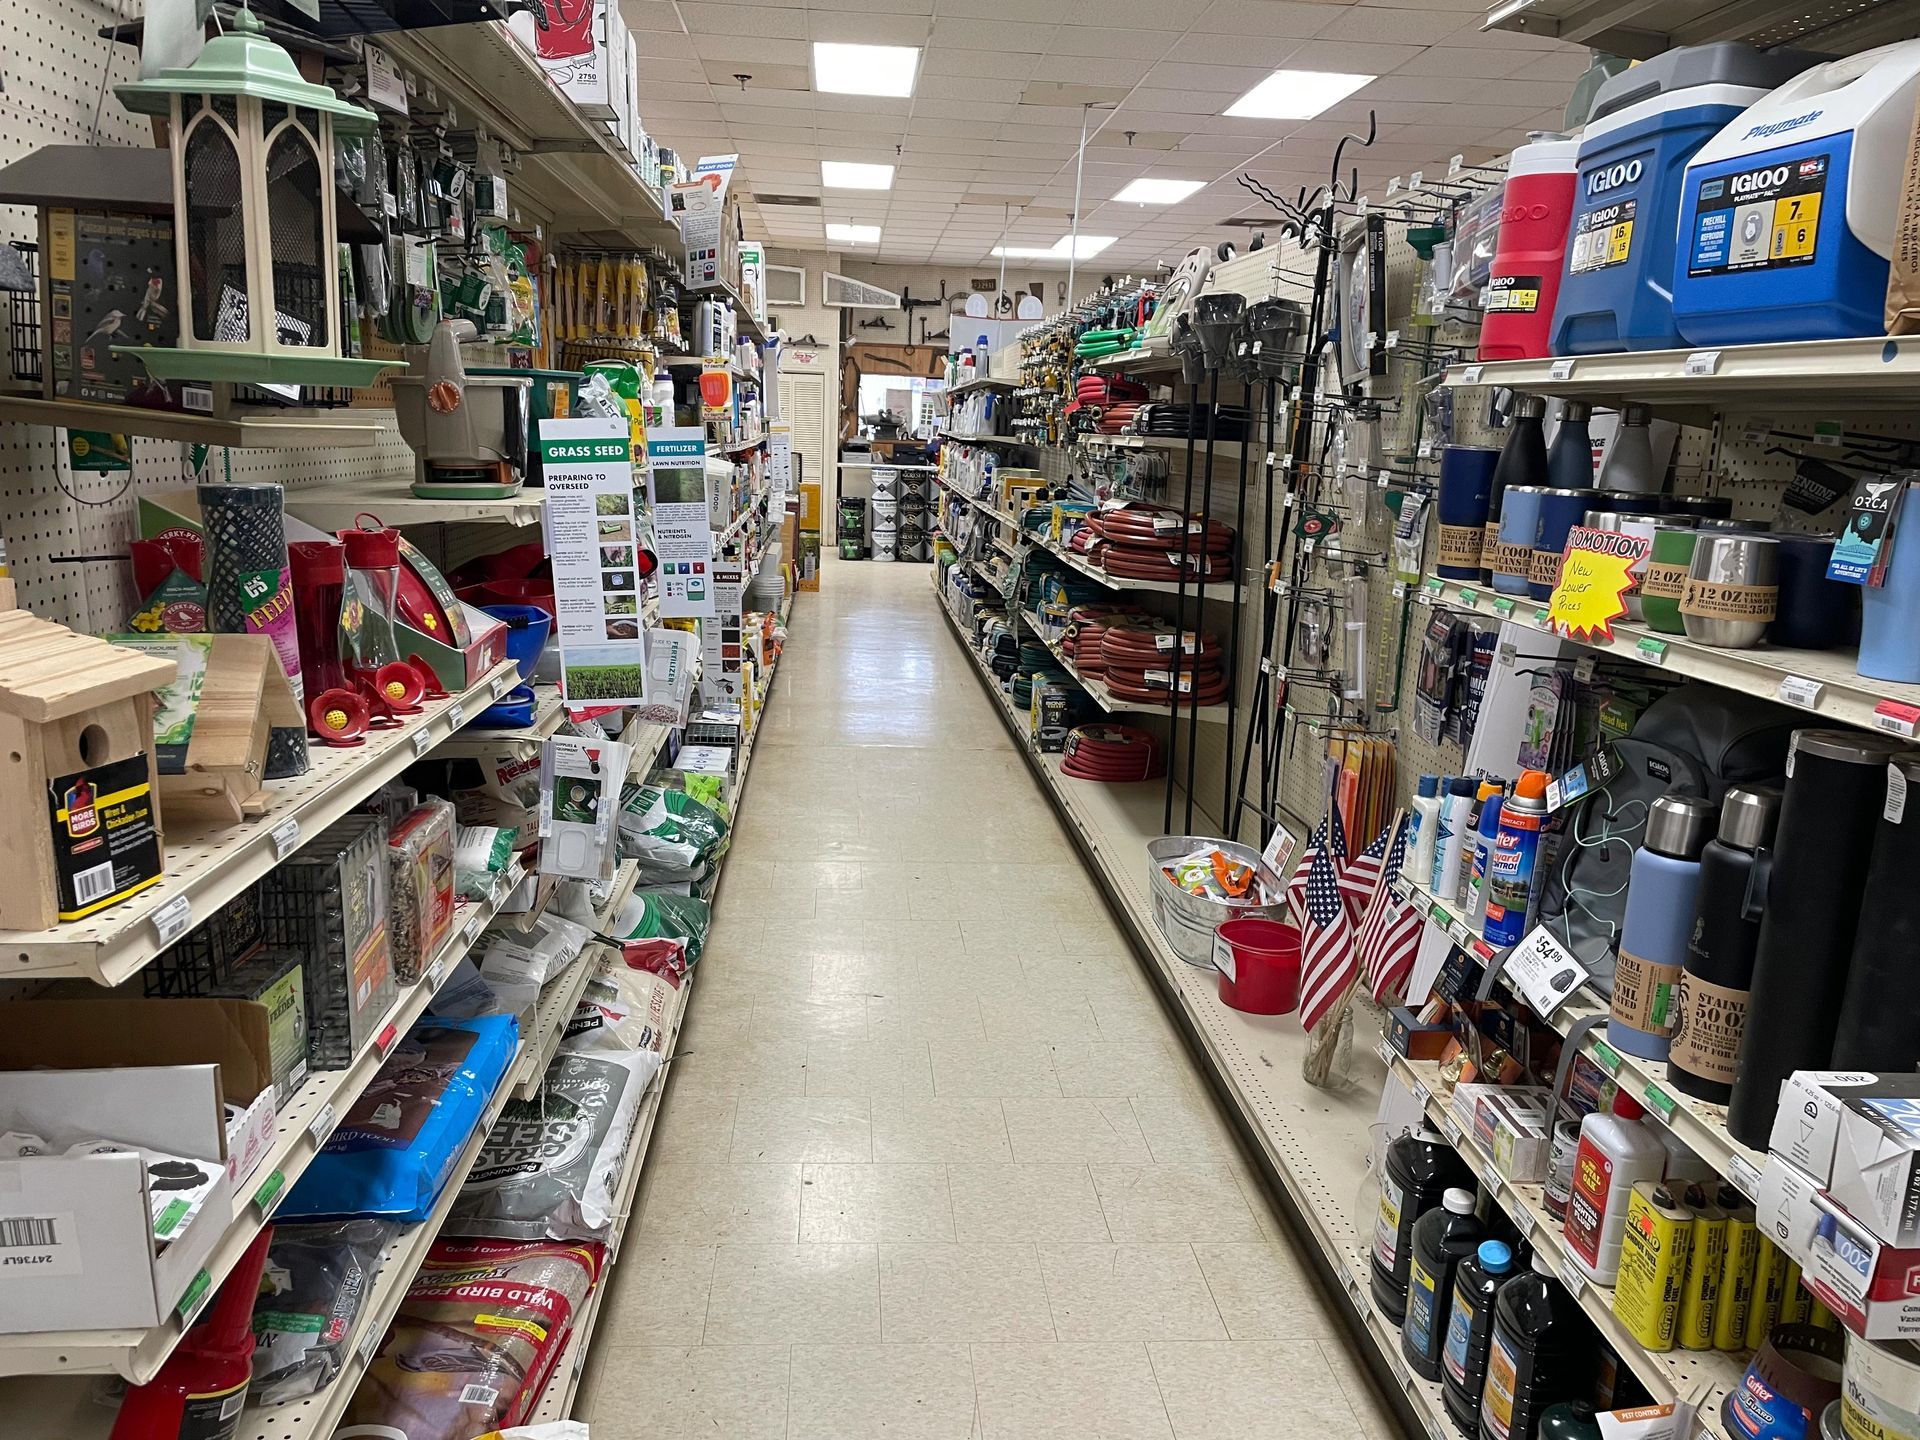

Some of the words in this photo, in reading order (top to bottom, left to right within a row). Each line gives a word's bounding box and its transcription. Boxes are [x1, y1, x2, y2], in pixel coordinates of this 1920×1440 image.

[1741, 110, 1823, 141] Playmate
[1587, 159, 1642, 196] IGLOO
[1730, 166, 1790, 195] IGLOO
[1590, 206, 1619, 225] IGLOO
[1790, 200, 1801, 221] 7
[1702, 215, 1726, 226] PRECHILL
[1614, 226, 1626, 240] 16
[1797, 228, 1806, 243] 6
[1618, 242, 1626, 252] 15
[1491, 277, 1515, 286] IGLOO
[548, 446, 590, 458] GRASS
[594, 445, 624, 456] SEED
[656, 445, 698, 453] FERTILIZER
[548, 474, 594, 482] PREPARING
[1854, 496, 1888, 510] ORCA
[1569, 560, 1594, 577] New
[1649, 568, 1660, 581] 12
[1664, 572, 1682, 584] OZ
[1562, 578, 1592, 592] Lower
[1558, 594, 1582, 610] Prices
[1700, 586, 1716, 600] 12
[1720, 589, 1743, 603] OZ
[168, 602, 201, 614] PERKY-PET
[1748, 604, 1768, 615] 350
[668, 641, 678, 684] FERTILIZER
[1600, 712, 1616, 728] Head
[1616, 718, 1628, 732] Net
[1598, 750, 1610, 778] IGLOO
[1648, 760, 1670, 774] IGLOO
[70, 810, 94, 824] MORE
[72, 818, 96, 832] BIRDS
[1496, 832, 1520, 850] tter
[1622, 986, 1638, 1002] ML
[270, 994, 296, 1024] FEEDER
[580, 1006, 598, 1014] THE
[1696, 1004, 1721, 1024] 50
[1694, 1017, 1743, 1038] VACUUM
[1690, 1040, 1709, 1052] HOT
[1711, 1046, 1731, 1059] FOR
[1582, 1160, 1601, 1186] ROYAL
[1582, 1173, 1597, 1192] OAK
[1386, 1209, 1396, 1224] FUEL
[1572, 1198, 1598, 1227] LIGHTER
[1574, 1210, 1592, 1230] FLUID
[1624, 1228, 1645, 1256] FONDUE
[1644, 1248, 1658, 1268] FUEL
[2, 1254, 53, 1266] 24736LF
[1840, 1242, 1870, 1273] 200
[344, 1268, 364, 1296] SEED
[1664, 1276, 1674, 1302] FONDUE
[1701, 1276, 1710, 1301] FONDUE
[1734, 1278, 1744, 1302] FONDUE
[456, 1286, 505, 1299] BIRD
[508, 1290, 554, 1310] WILD
[1746, 1375, 1774, 1401] Cutter
[1622, 1412, 1635, 1420] PEST
[1635, 1408, 1660, 1418] CONTROL
